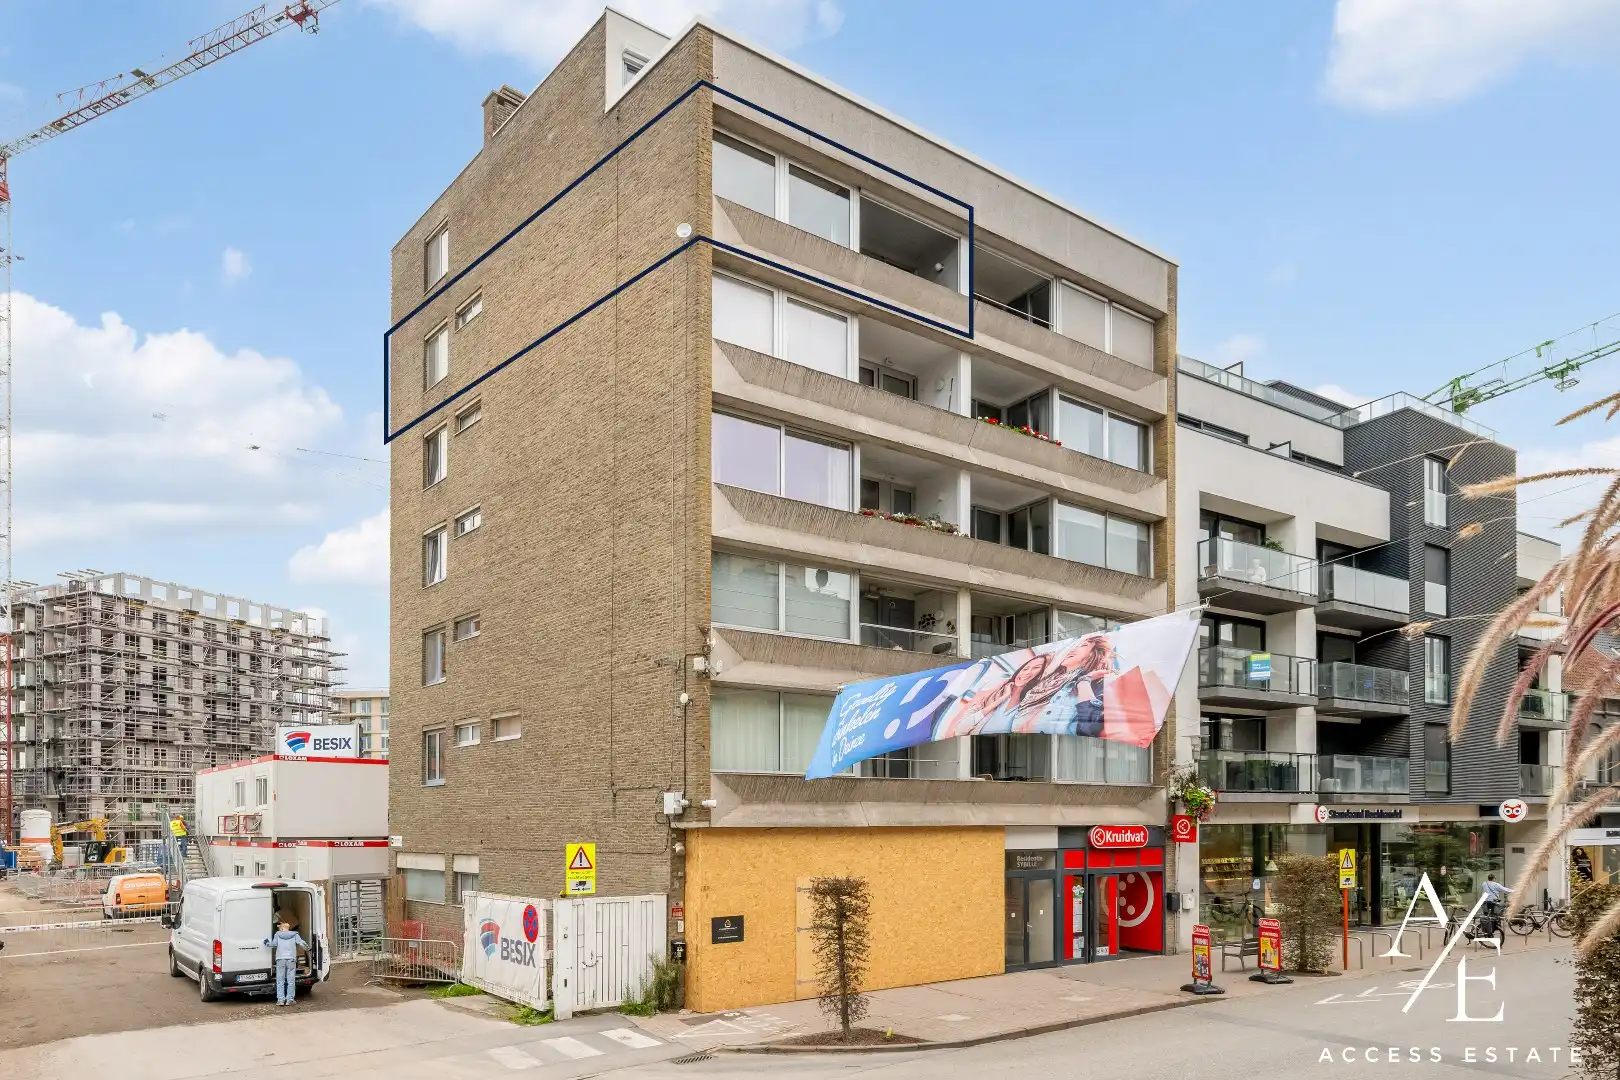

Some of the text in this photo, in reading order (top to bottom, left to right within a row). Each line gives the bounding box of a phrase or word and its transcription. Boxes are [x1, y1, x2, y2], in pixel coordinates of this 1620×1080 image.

[313, 737, 352, 751] BESIX
[1106, 830, 1145, 843] Kruidvat
[500, 937, 536, 968] BESIX
